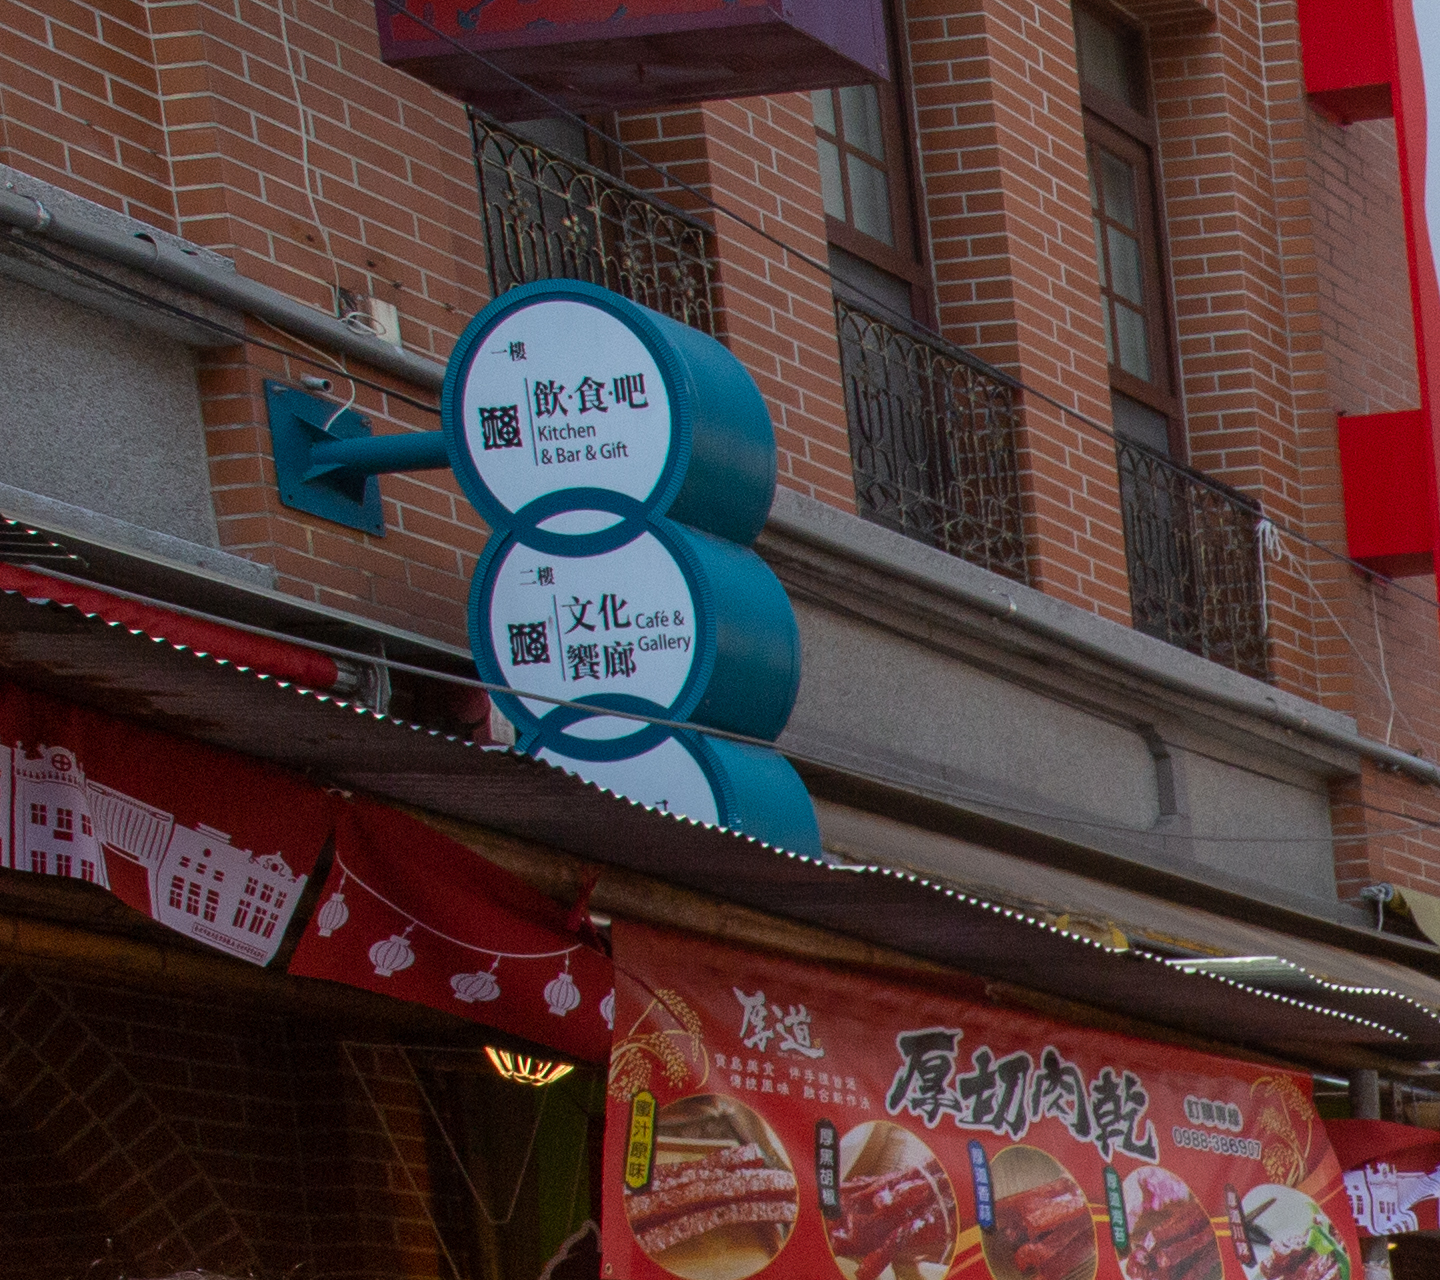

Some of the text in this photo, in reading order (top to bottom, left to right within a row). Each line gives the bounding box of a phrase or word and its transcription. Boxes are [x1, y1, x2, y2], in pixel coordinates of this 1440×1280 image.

[491, 341, 527, 361] 一樓
[537, 423, 596, 442] Kitchen
[541, 441, 629, 465] & Bar & Gift
[519, 566, 555, 586] 二樓
[562, 593, 632, 635] 文化
[635, 610, 685, 630] Café &
[637, 633, 692, 653] Gallery
